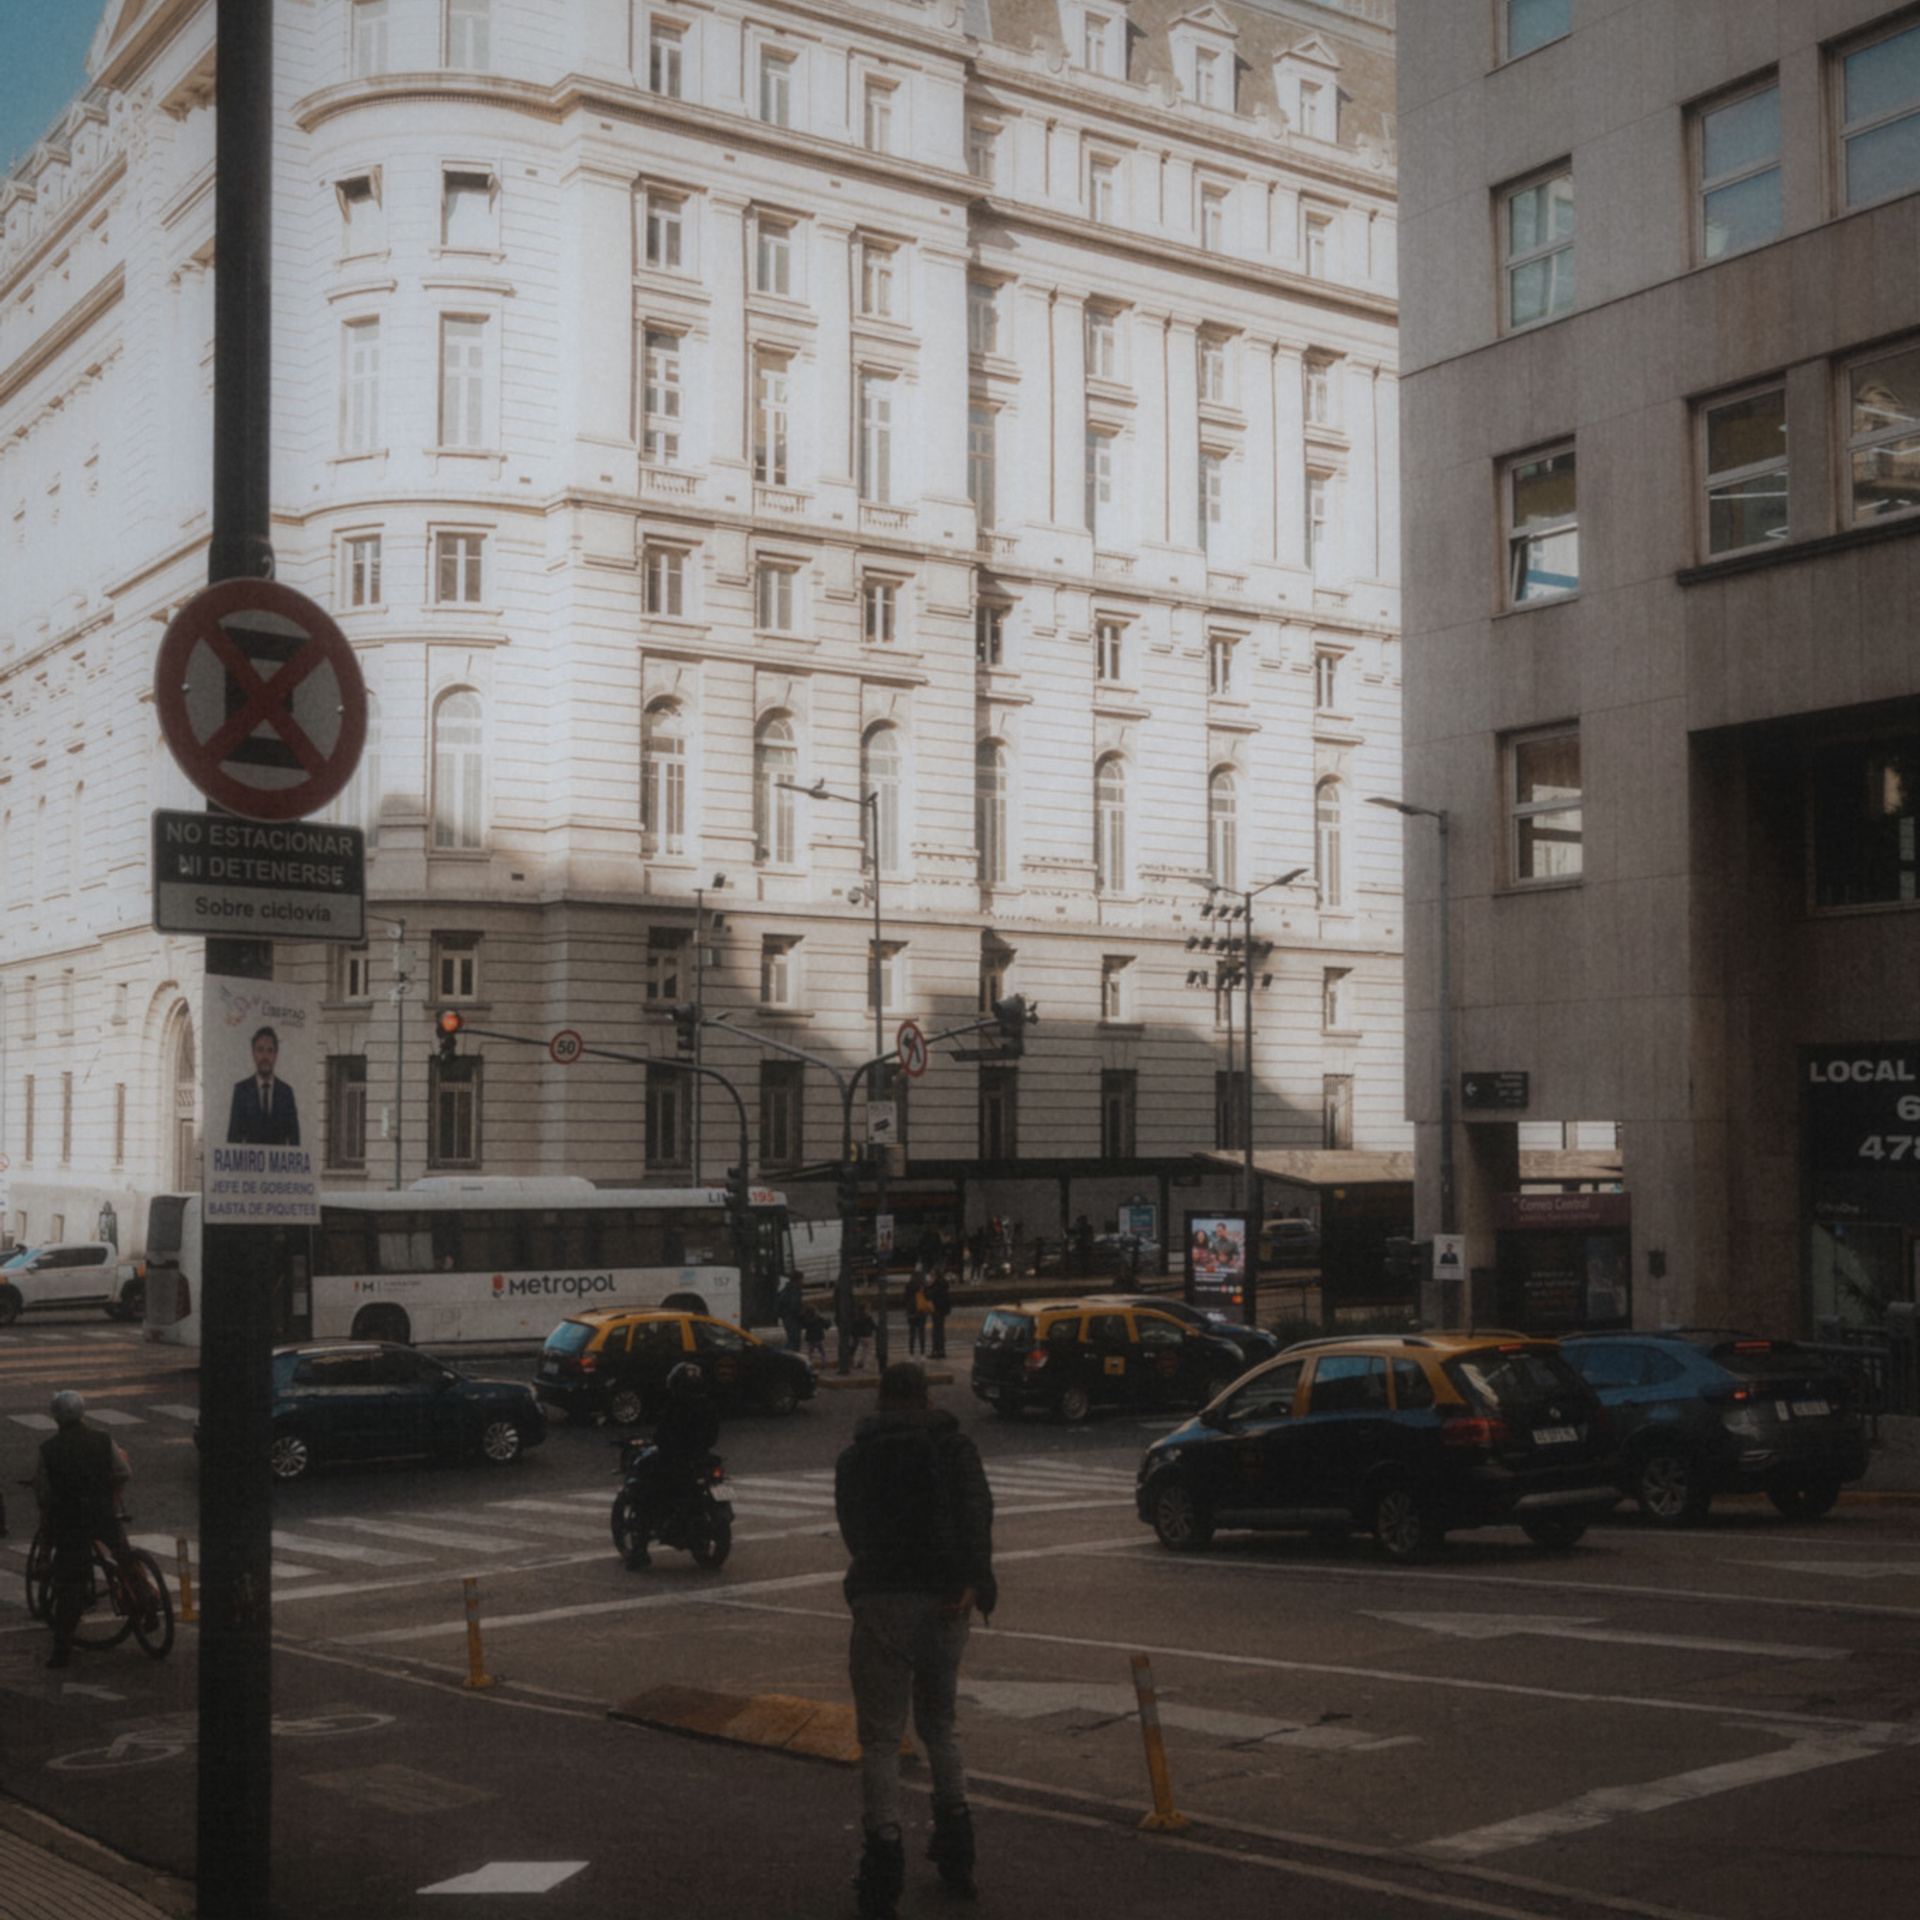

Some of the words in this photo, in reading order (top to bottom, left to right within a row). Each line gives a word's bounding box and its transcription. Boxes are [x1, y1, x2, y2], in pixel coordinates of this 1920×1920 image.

[166, 822, 201, 844] NO
[209, 825, 354, 856] ESTACIONAR
[178, 854, 201, 875] NI
[209, 856, 345, 886] DETENERSE
[195, 896, 254, 917] Sobre
[557, 1040, 576, 1055] 50
[1809, 1059, 1916, 1083] LOCAL
[1858, 1135, 1920, 1161] 47
[214, 1148, 266, 1173] RAMIRO
[269, 1150, 312, 1175] MARRA
[211, 1179, 239, 1194] JEFE
[242, 1180, 257, 1194] DE
[260, 1180, 315, 1196] GOBIERNO
[751, 1189, 776, 1203] 195
[209, 1201, 246, 1216] BASTA
[248, 1202, 263, 1216] DE
[266, 1202, 317, 1217] PIQUETES
[509, 1273, 616, 1297] Metropol
